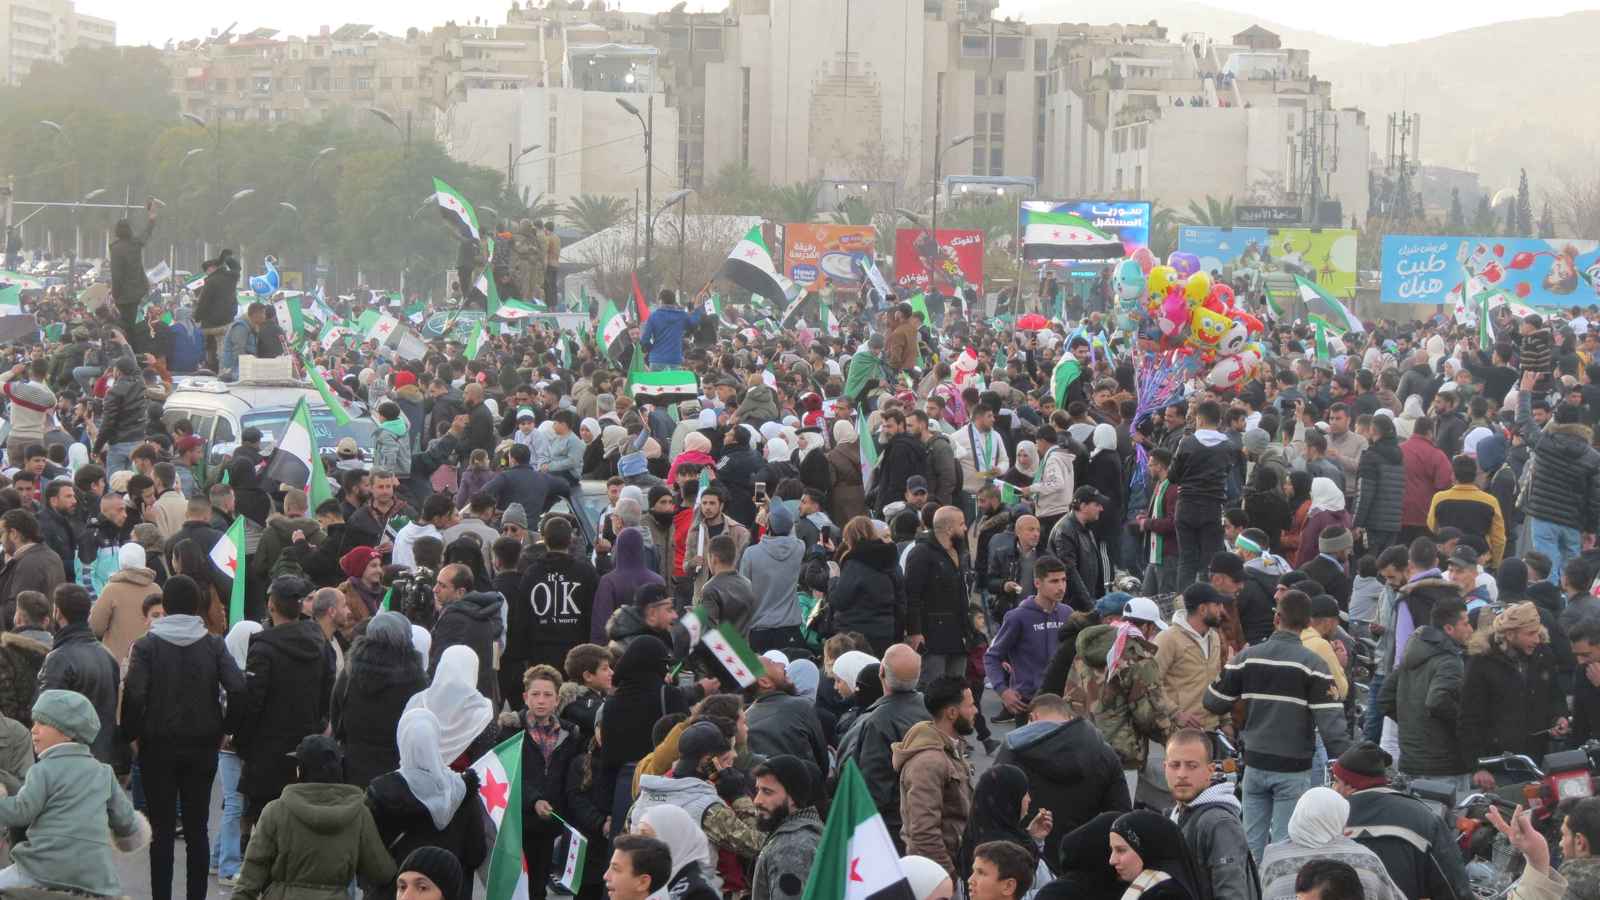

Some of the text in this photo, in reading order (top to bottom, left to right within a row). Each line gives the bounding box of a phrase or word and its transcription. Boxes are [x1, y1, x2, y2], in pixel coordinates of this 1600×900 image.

[1092, 205, 1142, 217] سوريا
[1092, 217, 1142, 227] المستقبل
[1396, 254, 1446, 279] طيب
[1398, 274, 1442, 298] هيك
[548, 572, 564, 581] it's
